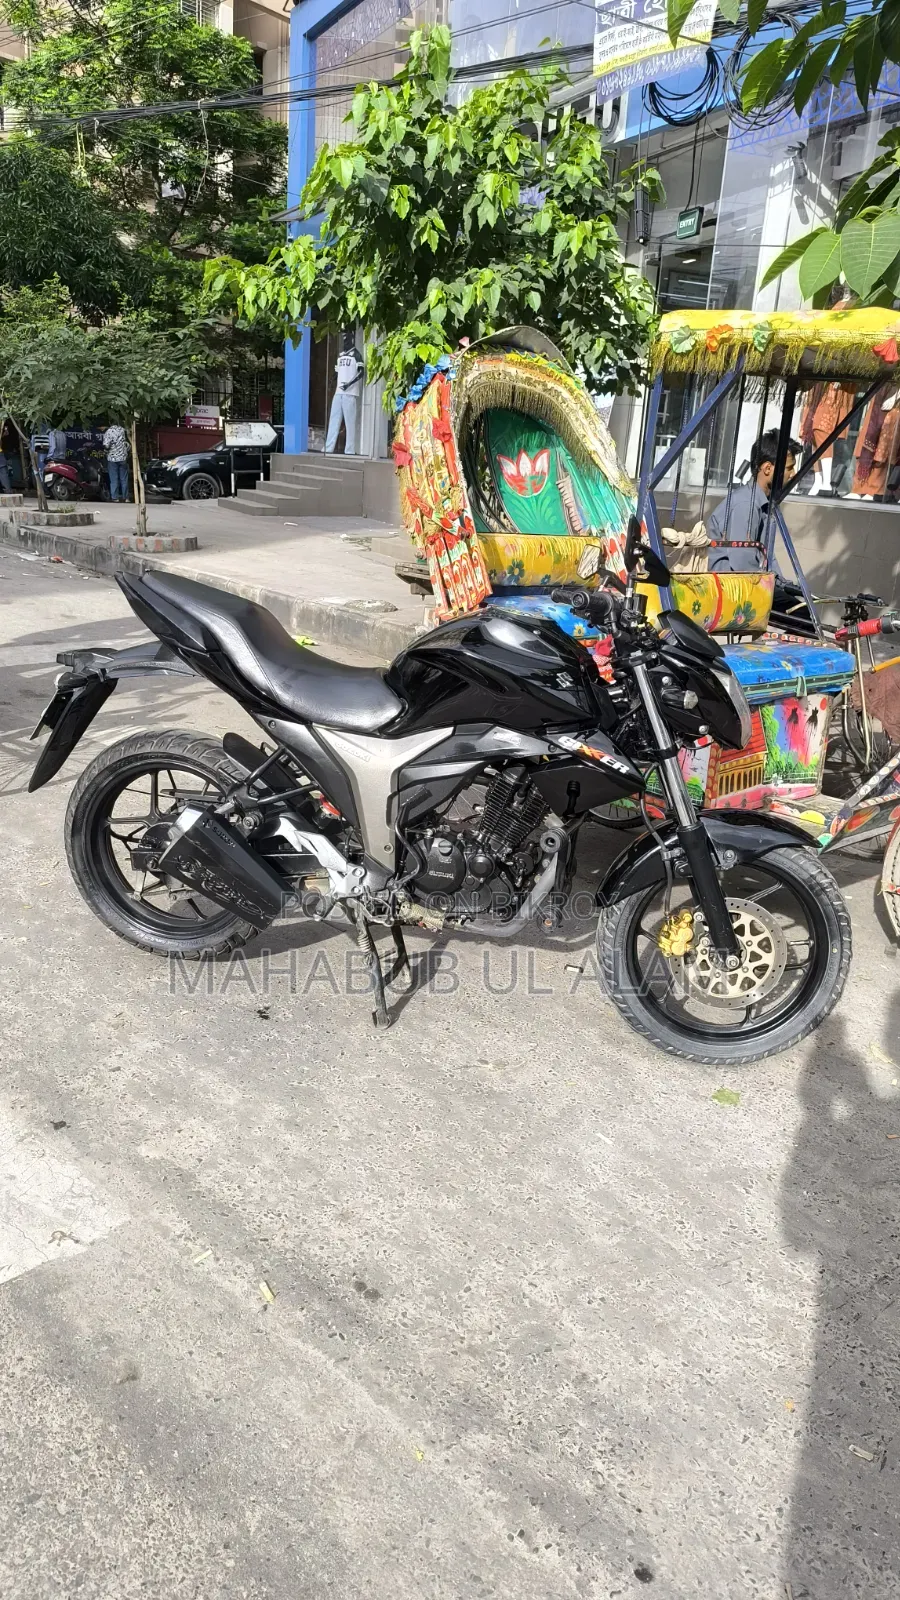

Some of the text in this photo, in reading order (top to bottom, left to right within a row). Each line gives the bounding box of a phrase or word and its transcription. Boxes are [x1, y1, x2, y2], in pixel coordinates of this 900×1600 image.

[679, 217, 696, 229] ENTRY
[334, 742, 371, 763] SUZUKI
[557, 735, 631, 775] GIXXER
